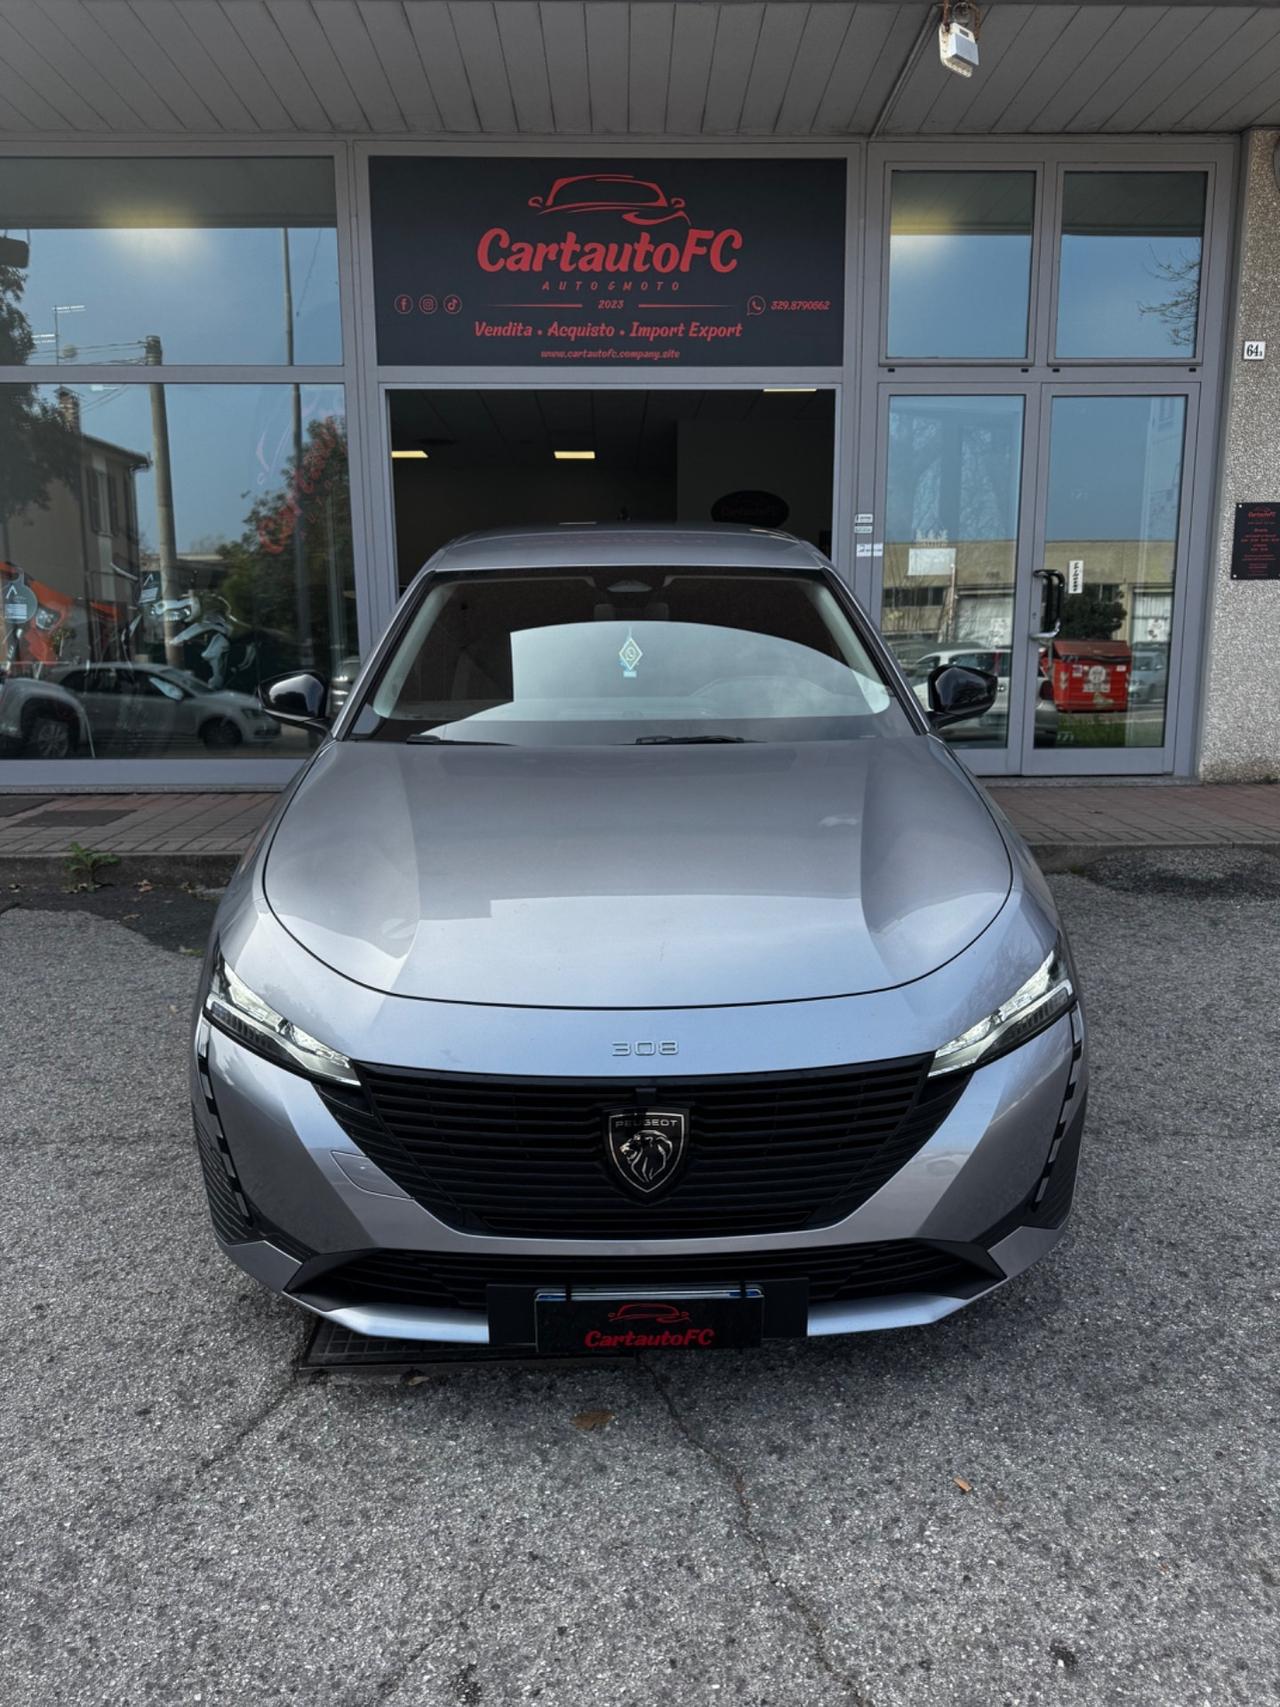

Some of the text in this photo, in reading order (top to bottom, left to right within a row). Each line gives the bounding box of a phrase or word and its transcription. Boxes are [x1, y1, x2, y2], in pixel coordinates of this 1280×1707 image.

[478, 227, 743, 274] CartautoFC
[598, 299, 625, 310] 2023
[474, 321, 743, 341] Vendita Acquisto Import Export
[611, 1039, 680, 1057] 308
[615, 1118, 679, 1128] PEUGEOT
[583, 1328, 716, 1349] CartautoFC
